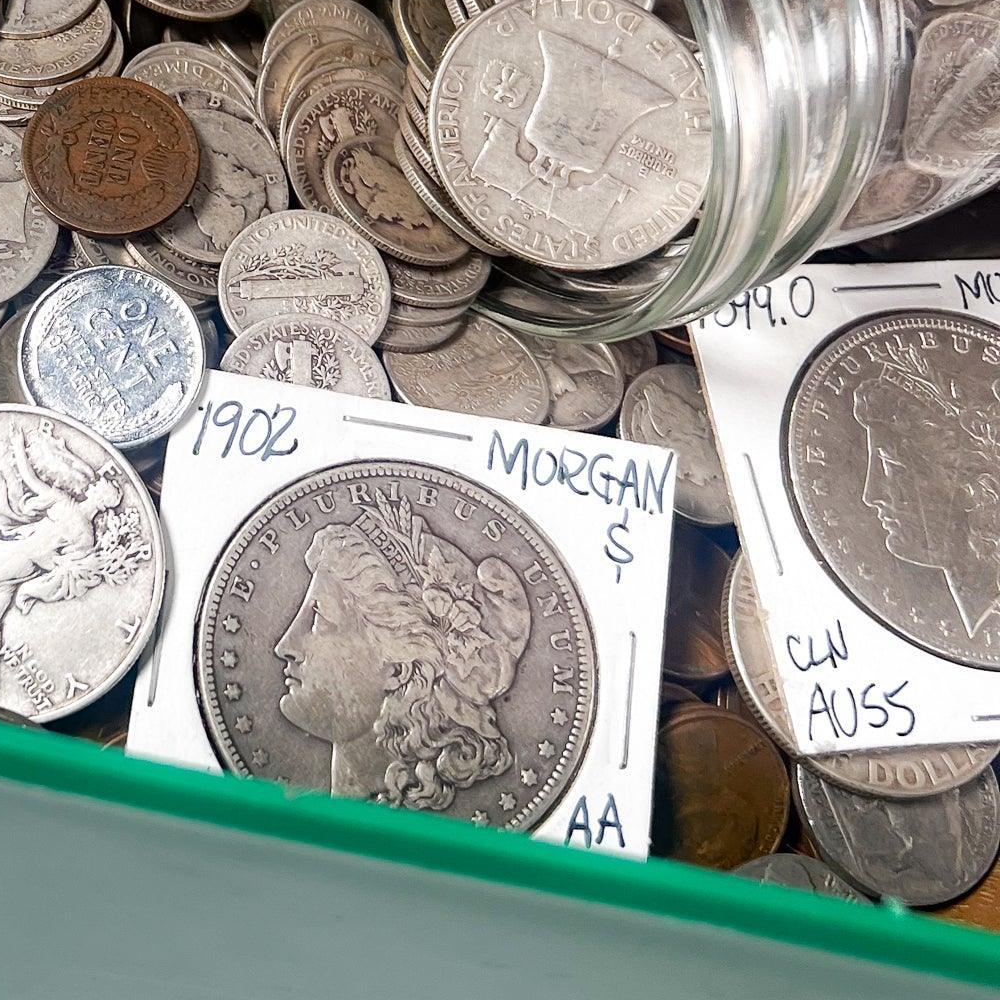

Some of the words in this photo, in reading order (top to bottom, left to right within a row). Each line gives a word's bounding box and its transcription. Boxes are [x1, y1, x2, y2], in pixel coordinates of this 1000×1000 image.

[646, 39, 712, 137] HALF
[80, 113, 118, 187] CENT
[108, 126, 141, 185] ONE
[438, 63, 475, 190] AMERICA
[462, 190, 491, 221] OF
[495, 213, 599, 259] STATES
[612, 181, 700, 253] UNITED
[89, 306, 157, 392] CENT
[120, 296, 180, 368] ONE
[252, 321, 311, 350] STATES
[193, 400, 299, 460] 1902
[487, 429, 677, 515] MORGAN
[604, 506, 634, 584] $
[265, 480, 506, 556] PLURIBUS
[522, 561, 577, 697] UNUM
[13, 663, 54, 712] TRUST
[24, 658, 56, 694] GOD
[564, 792, 626, 850] AA
